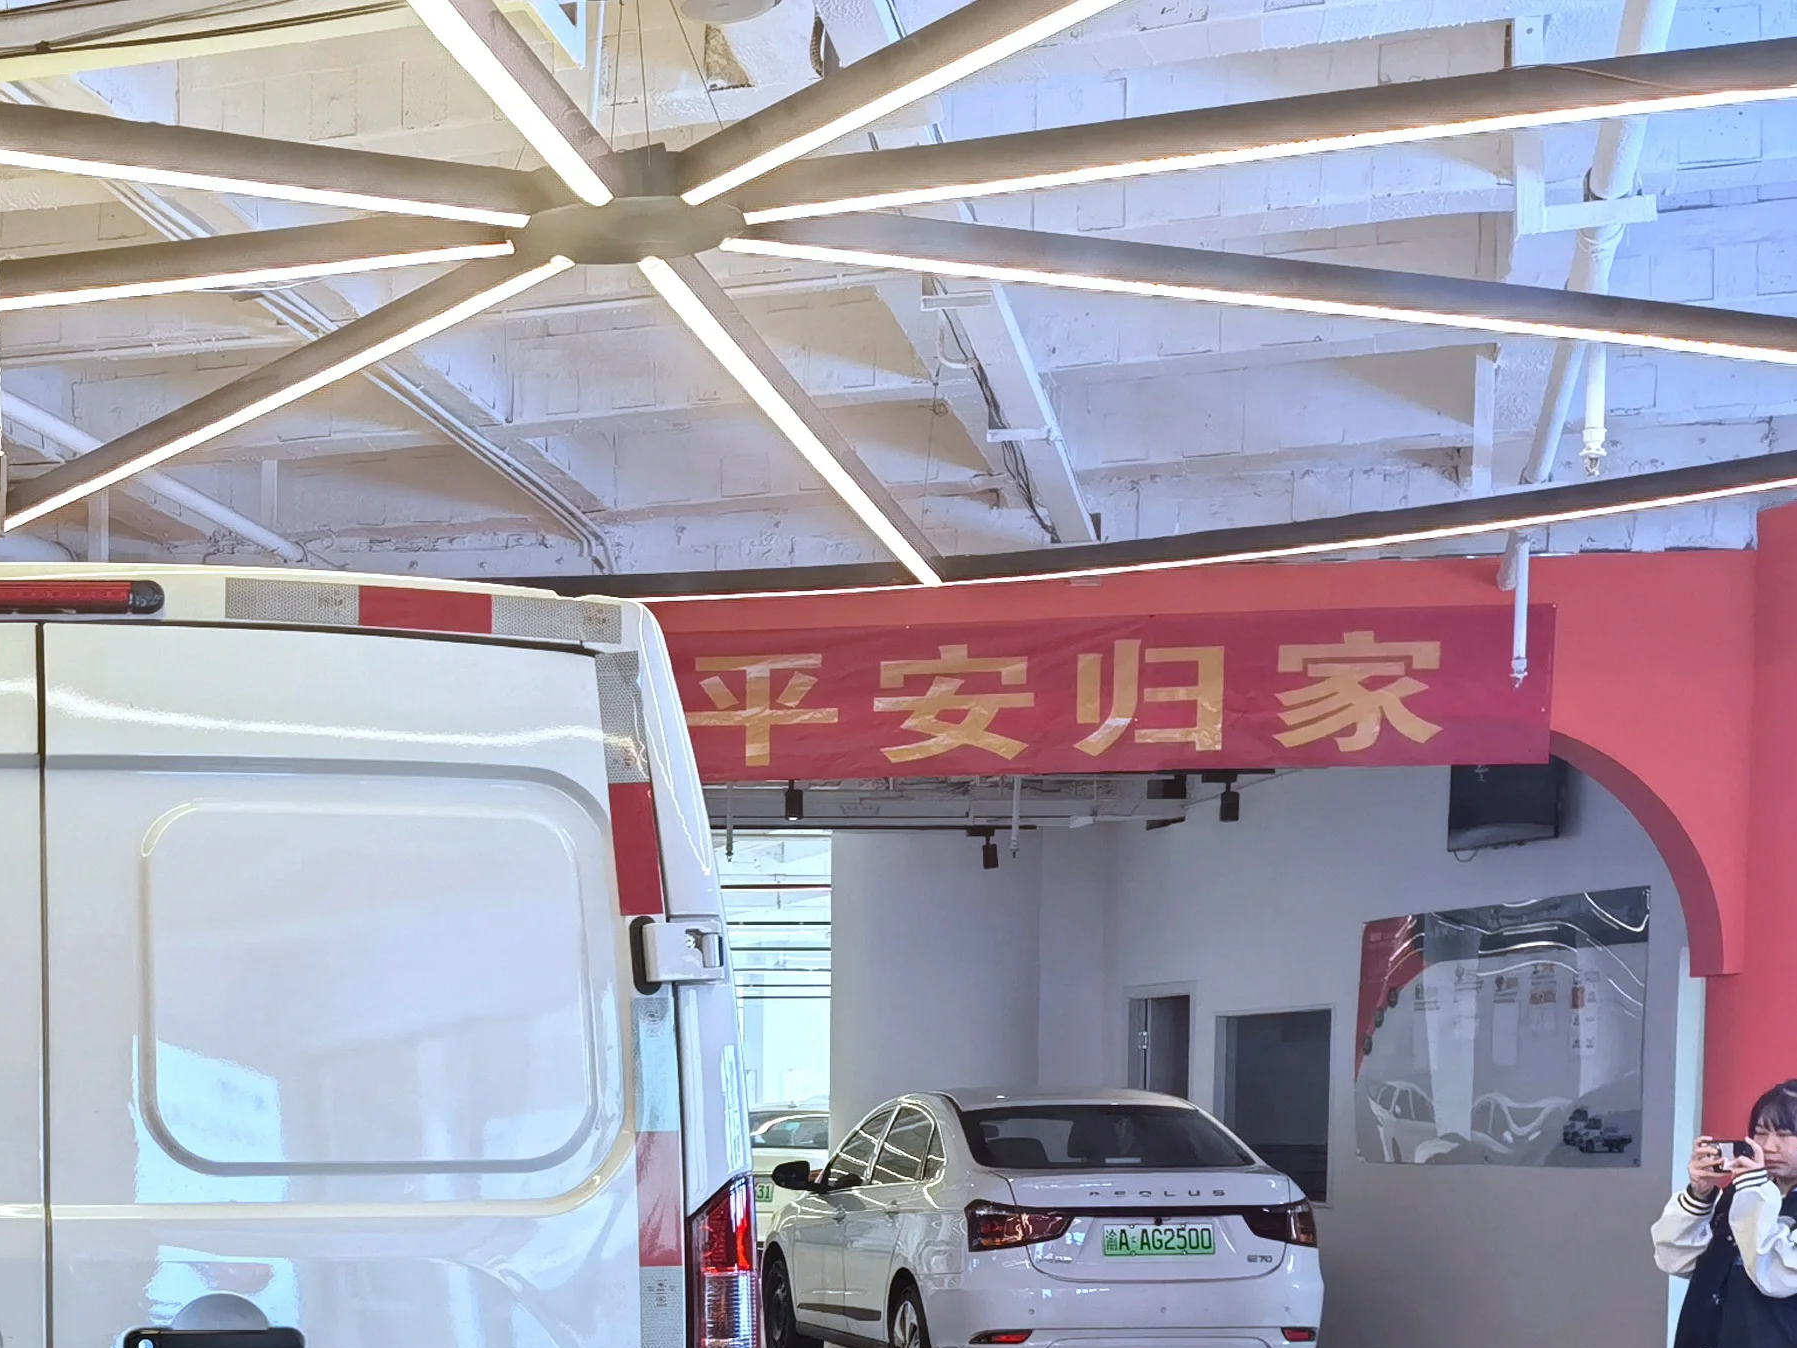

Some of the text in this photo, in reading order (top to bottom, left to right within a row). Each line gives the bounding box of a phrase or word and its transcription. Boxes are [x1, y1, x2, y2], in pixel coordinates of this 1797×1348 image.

[685, 630, 1443, 766] 平安归家
[1140, 1228, 1212, 1250] AG2500
[1247, 1255, 1272, 1263] E70
